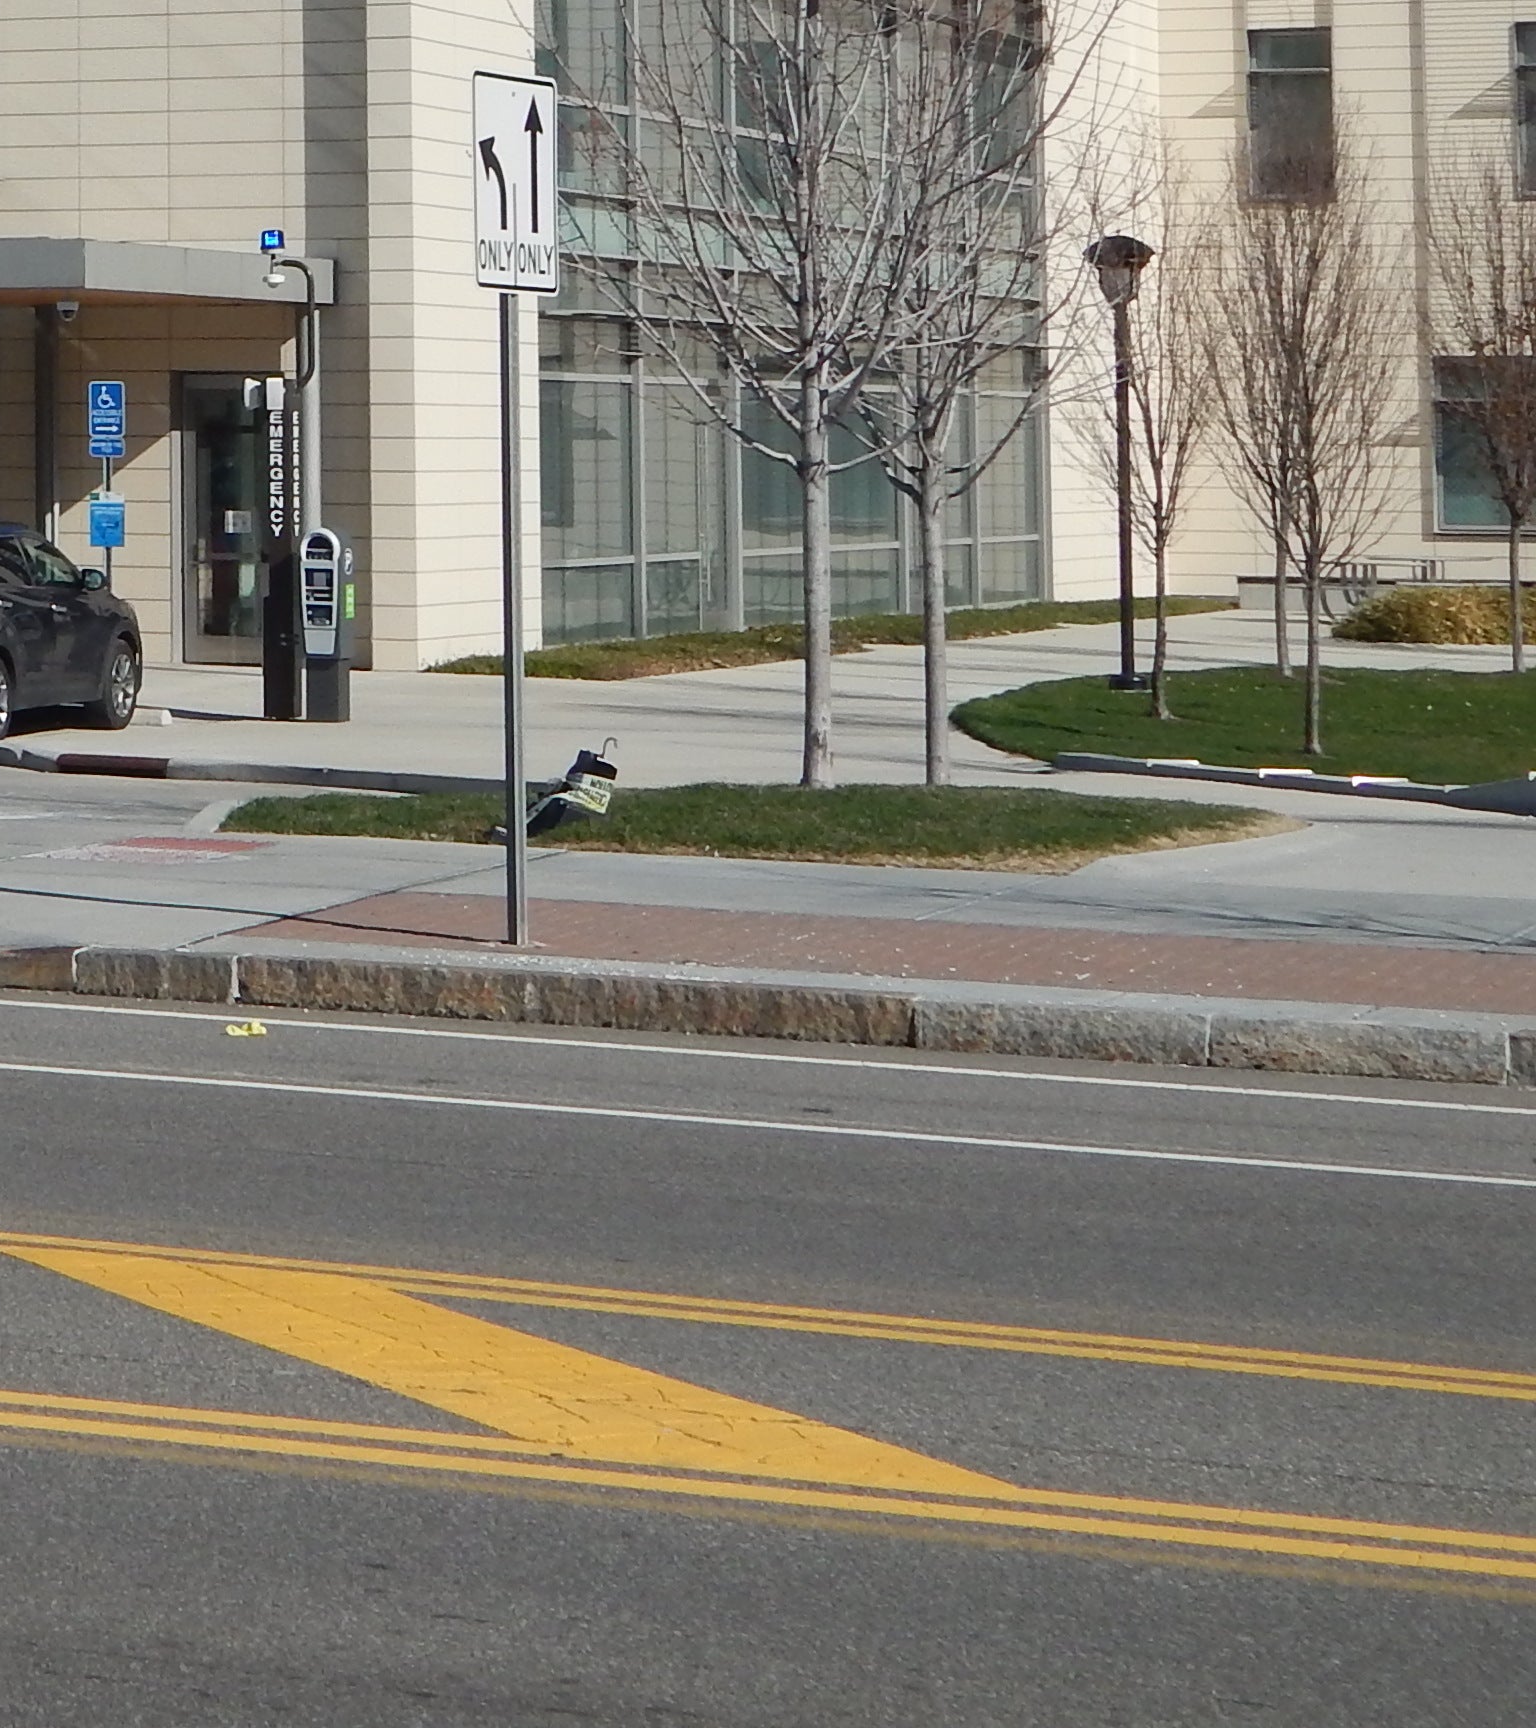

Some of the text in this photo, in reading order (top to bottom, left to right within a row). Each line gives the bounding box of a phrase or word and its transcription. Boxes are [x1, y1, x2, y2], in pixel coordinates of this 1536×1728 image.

[479, 239, 514, 272] ONLY
[518, 243, 554, 275] ONLY
[269, 411, 284, 537] EMERGENCY
